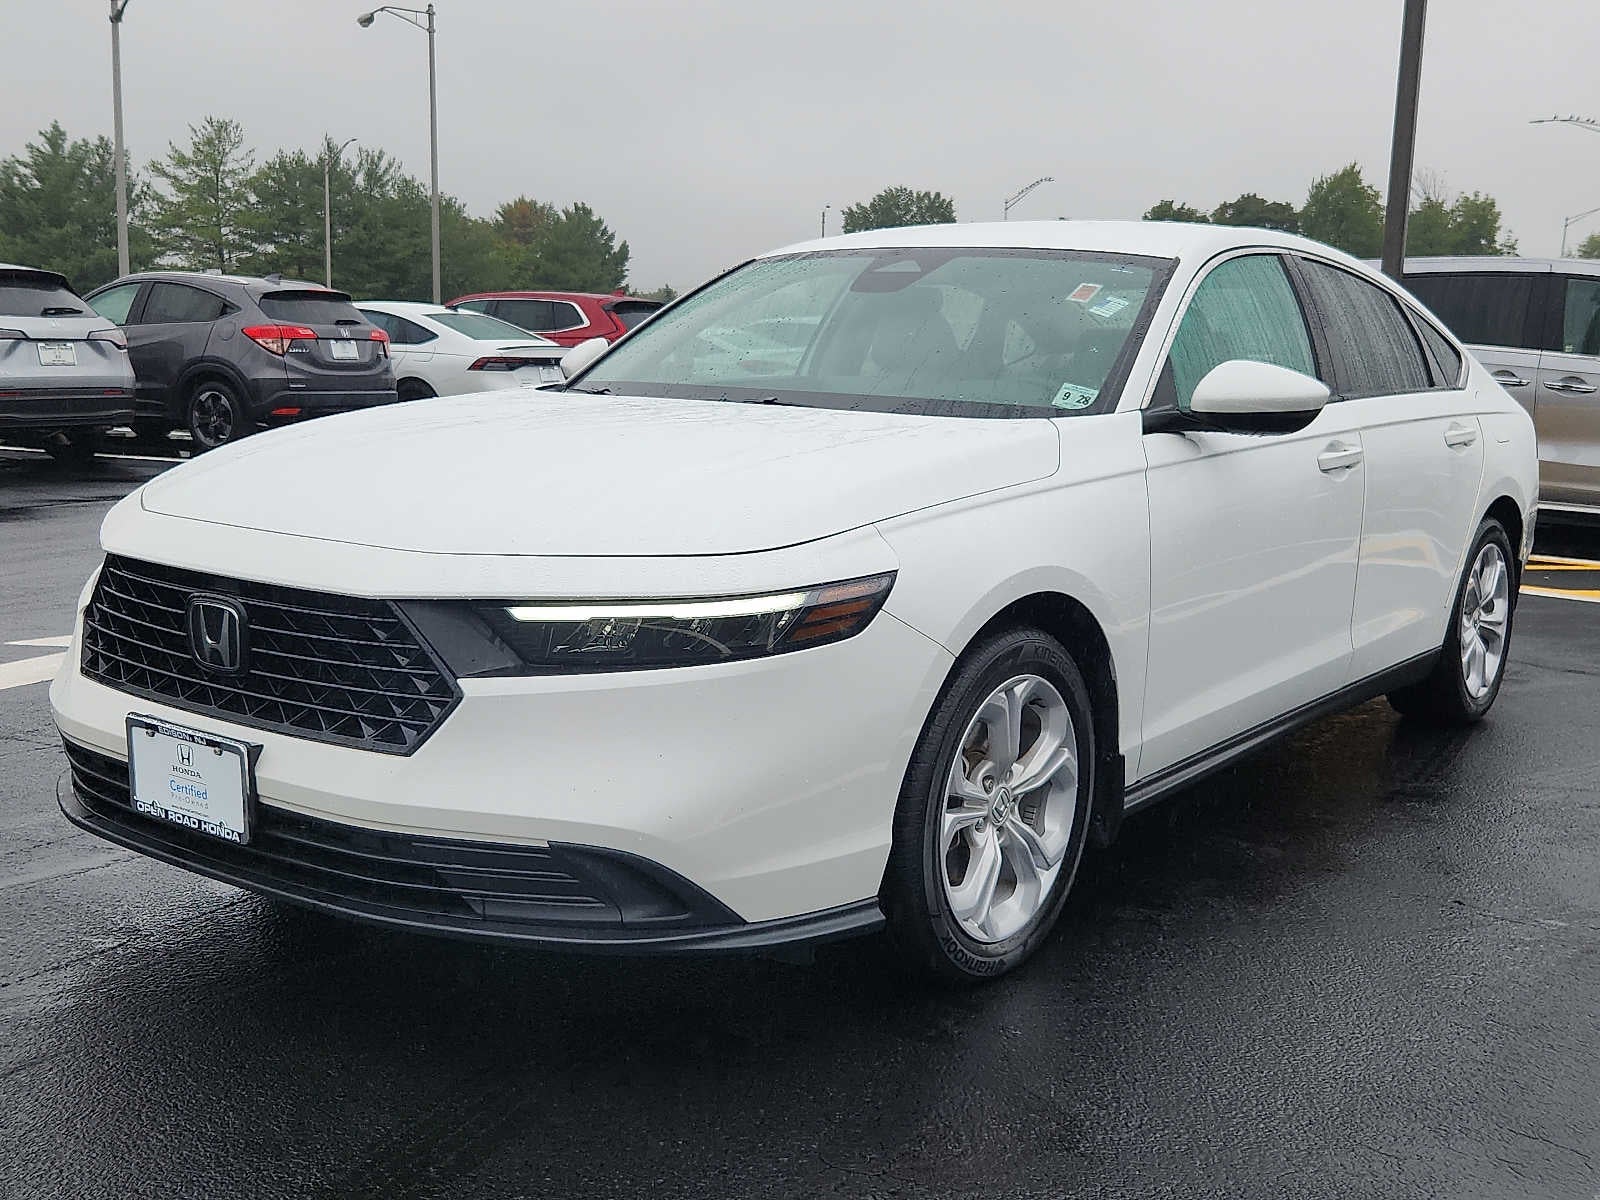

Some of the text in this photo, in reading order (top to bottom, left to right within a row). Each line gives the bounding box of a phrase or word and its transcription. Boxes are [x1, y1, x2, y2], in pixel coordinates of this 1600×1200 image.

[194, 737, 207, 746] NJ
[172, 766, 202, 778] HONDA
[170, 780, 208, 800] Certified
[137, 801, 165, 819] OPEN
[168, 811, 199, 829] ROAD
[201, 821, 240, 843] HONDA
